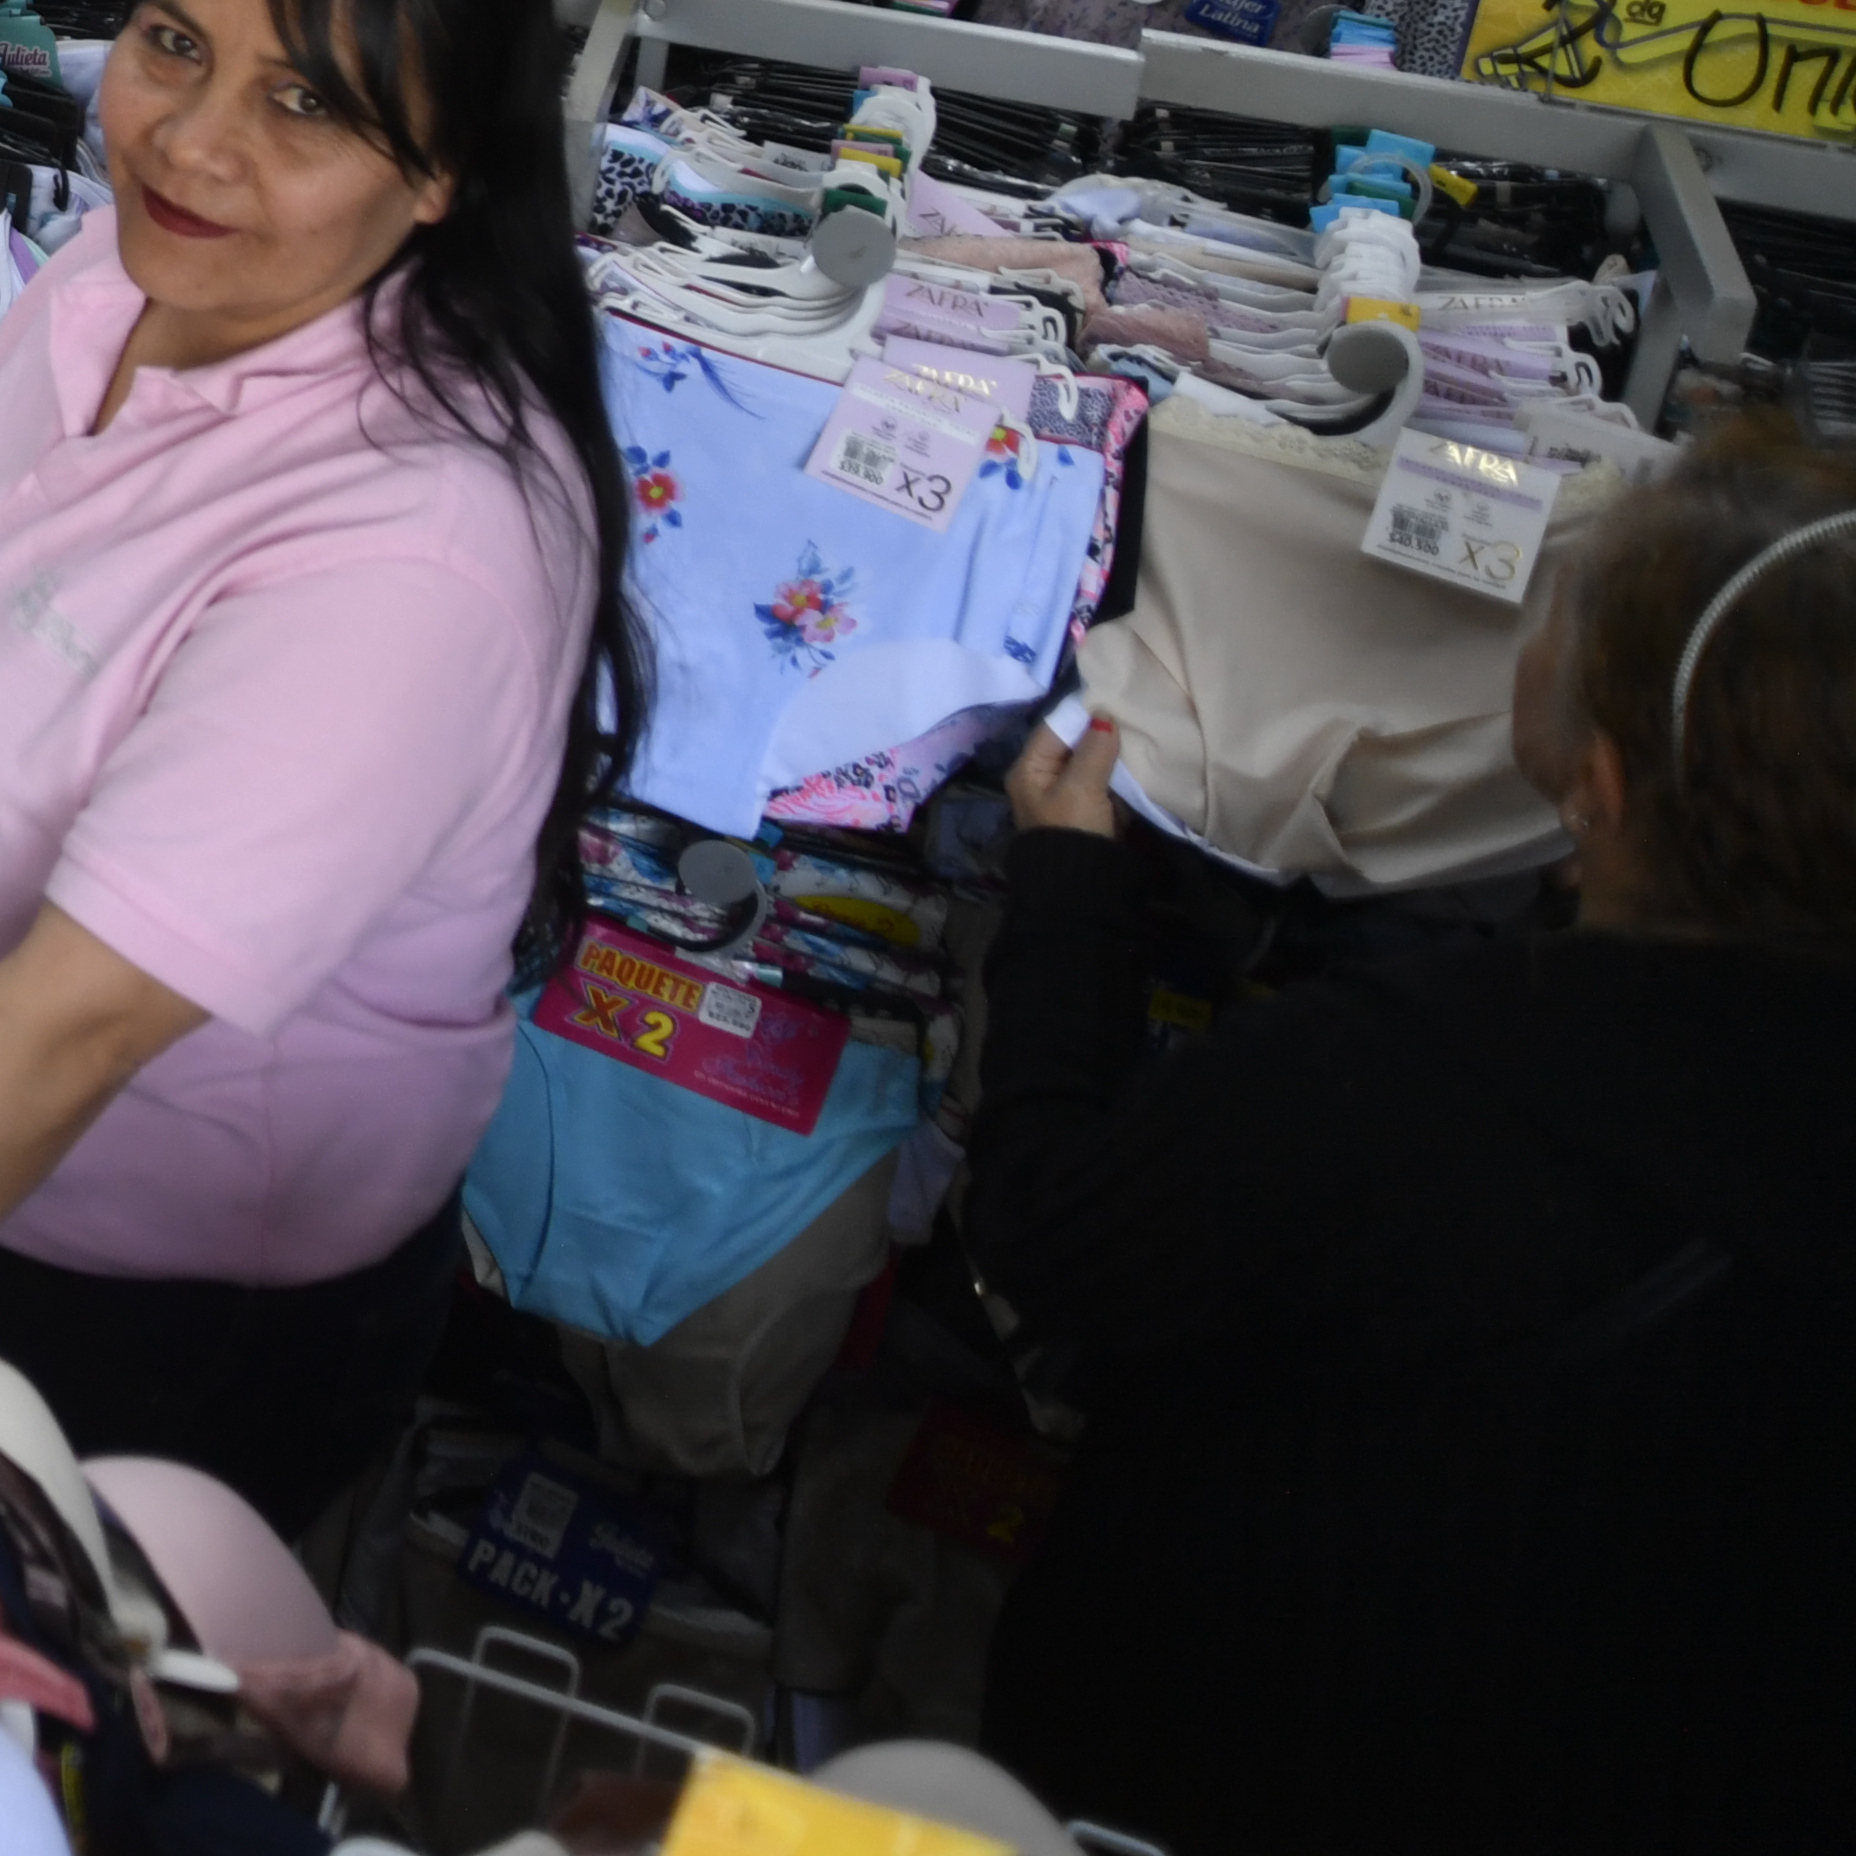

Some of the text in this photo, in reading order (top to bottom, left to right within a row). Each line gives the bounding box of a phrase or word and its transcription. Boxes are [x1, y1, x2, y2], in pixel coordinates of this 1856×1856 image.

[1199, 4, 1260, 34] Latina
[577, 941, 704, 1016] PAQUETE
[468, 1538, 559, 1609] PACK
